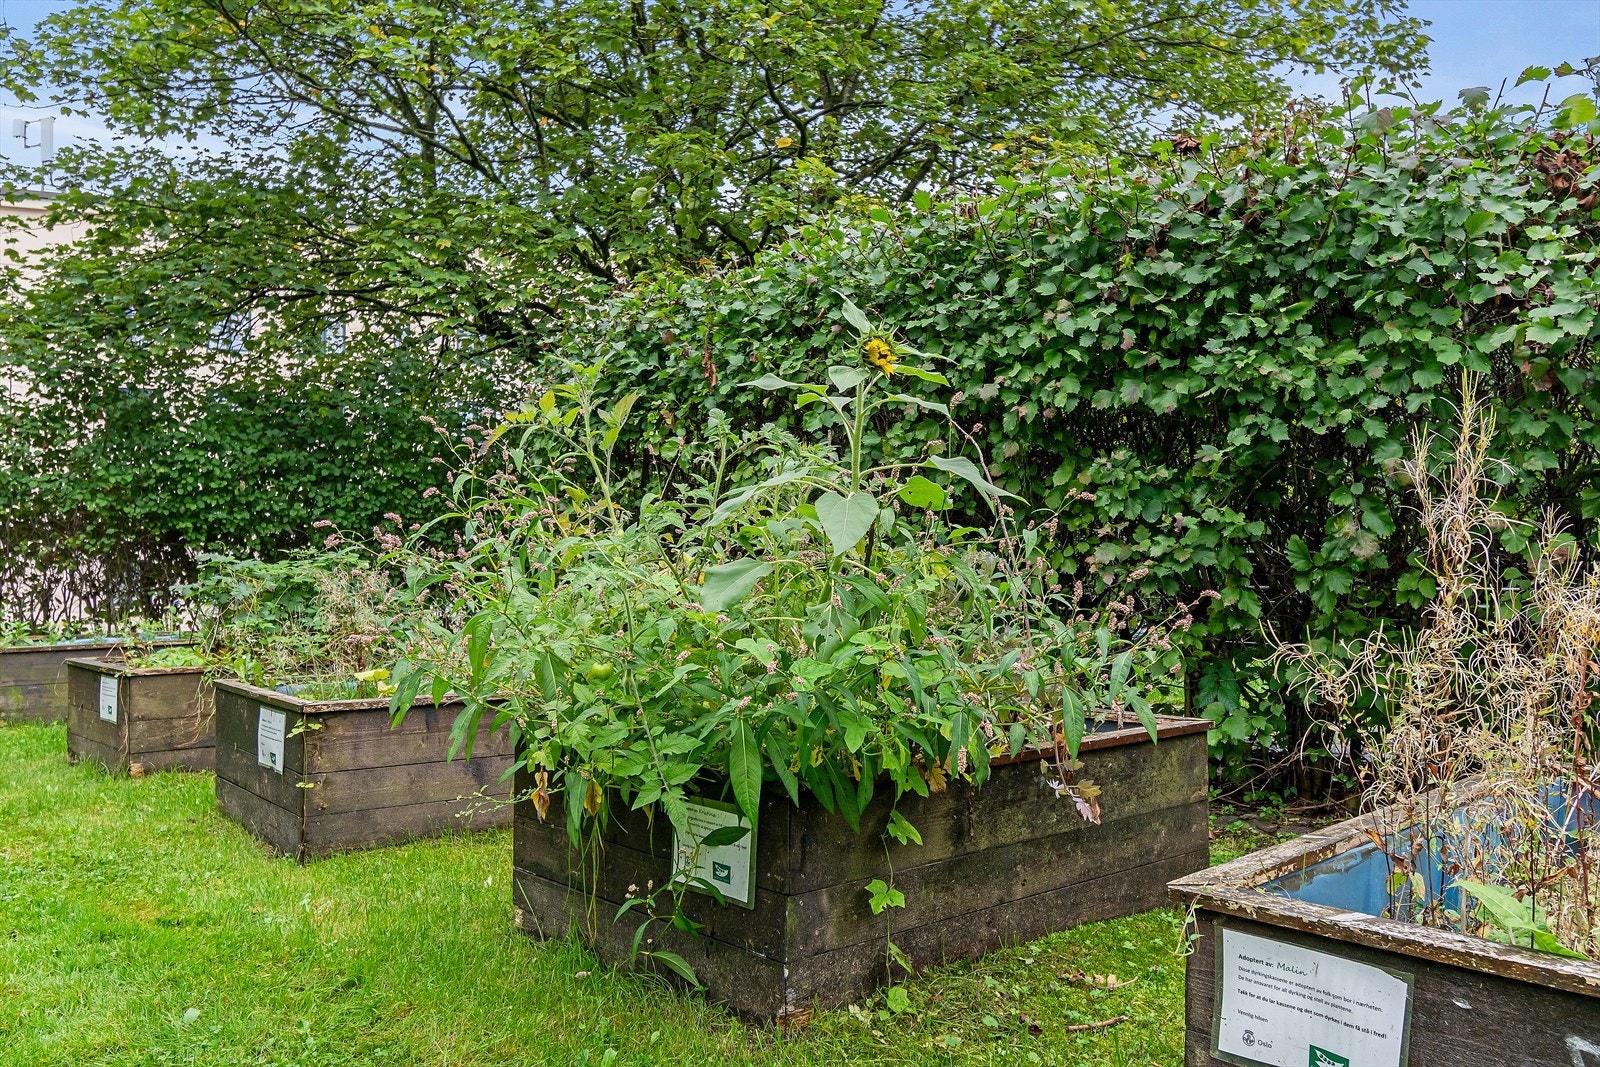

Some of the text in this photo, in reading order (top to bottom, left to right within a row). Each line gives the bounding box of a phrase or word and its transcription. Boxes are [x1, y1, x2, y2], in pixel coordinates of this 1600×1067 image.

[1238, 953, 1264, 965] Adoptert
[1277, 962, 1307, 976] Malin
[1238, 965, 1250, 973] Disse
[1251, 969, 1288, 984] dyrkingskassene
[1295, 982, 1316, 992] adoptert
[1322, 989, 1331, 997] folk
[1356, 1000, 1383, 1013] nærheten.
[1253, 979, 1273, 989] ansvaret
[1288, 989, 1306, 999] dyrking
[1314, 996, 1324, 1004] stell
[1330, 1002, 1354, 1014] plantene.
[1237, 988, 1248, 996] Takk
[1276, 1000, 1296, 1010] kassene
[1324, 1014, 1340, 1025] dyrkes
[1343, 1021, 1354, 1029] dem
[1373, 1030, 1387, 1039] fred!
[1237, 1009, 1269, 1023] Vennlig hilsen
[1257, 1039, 1273, 1049] Oslo
